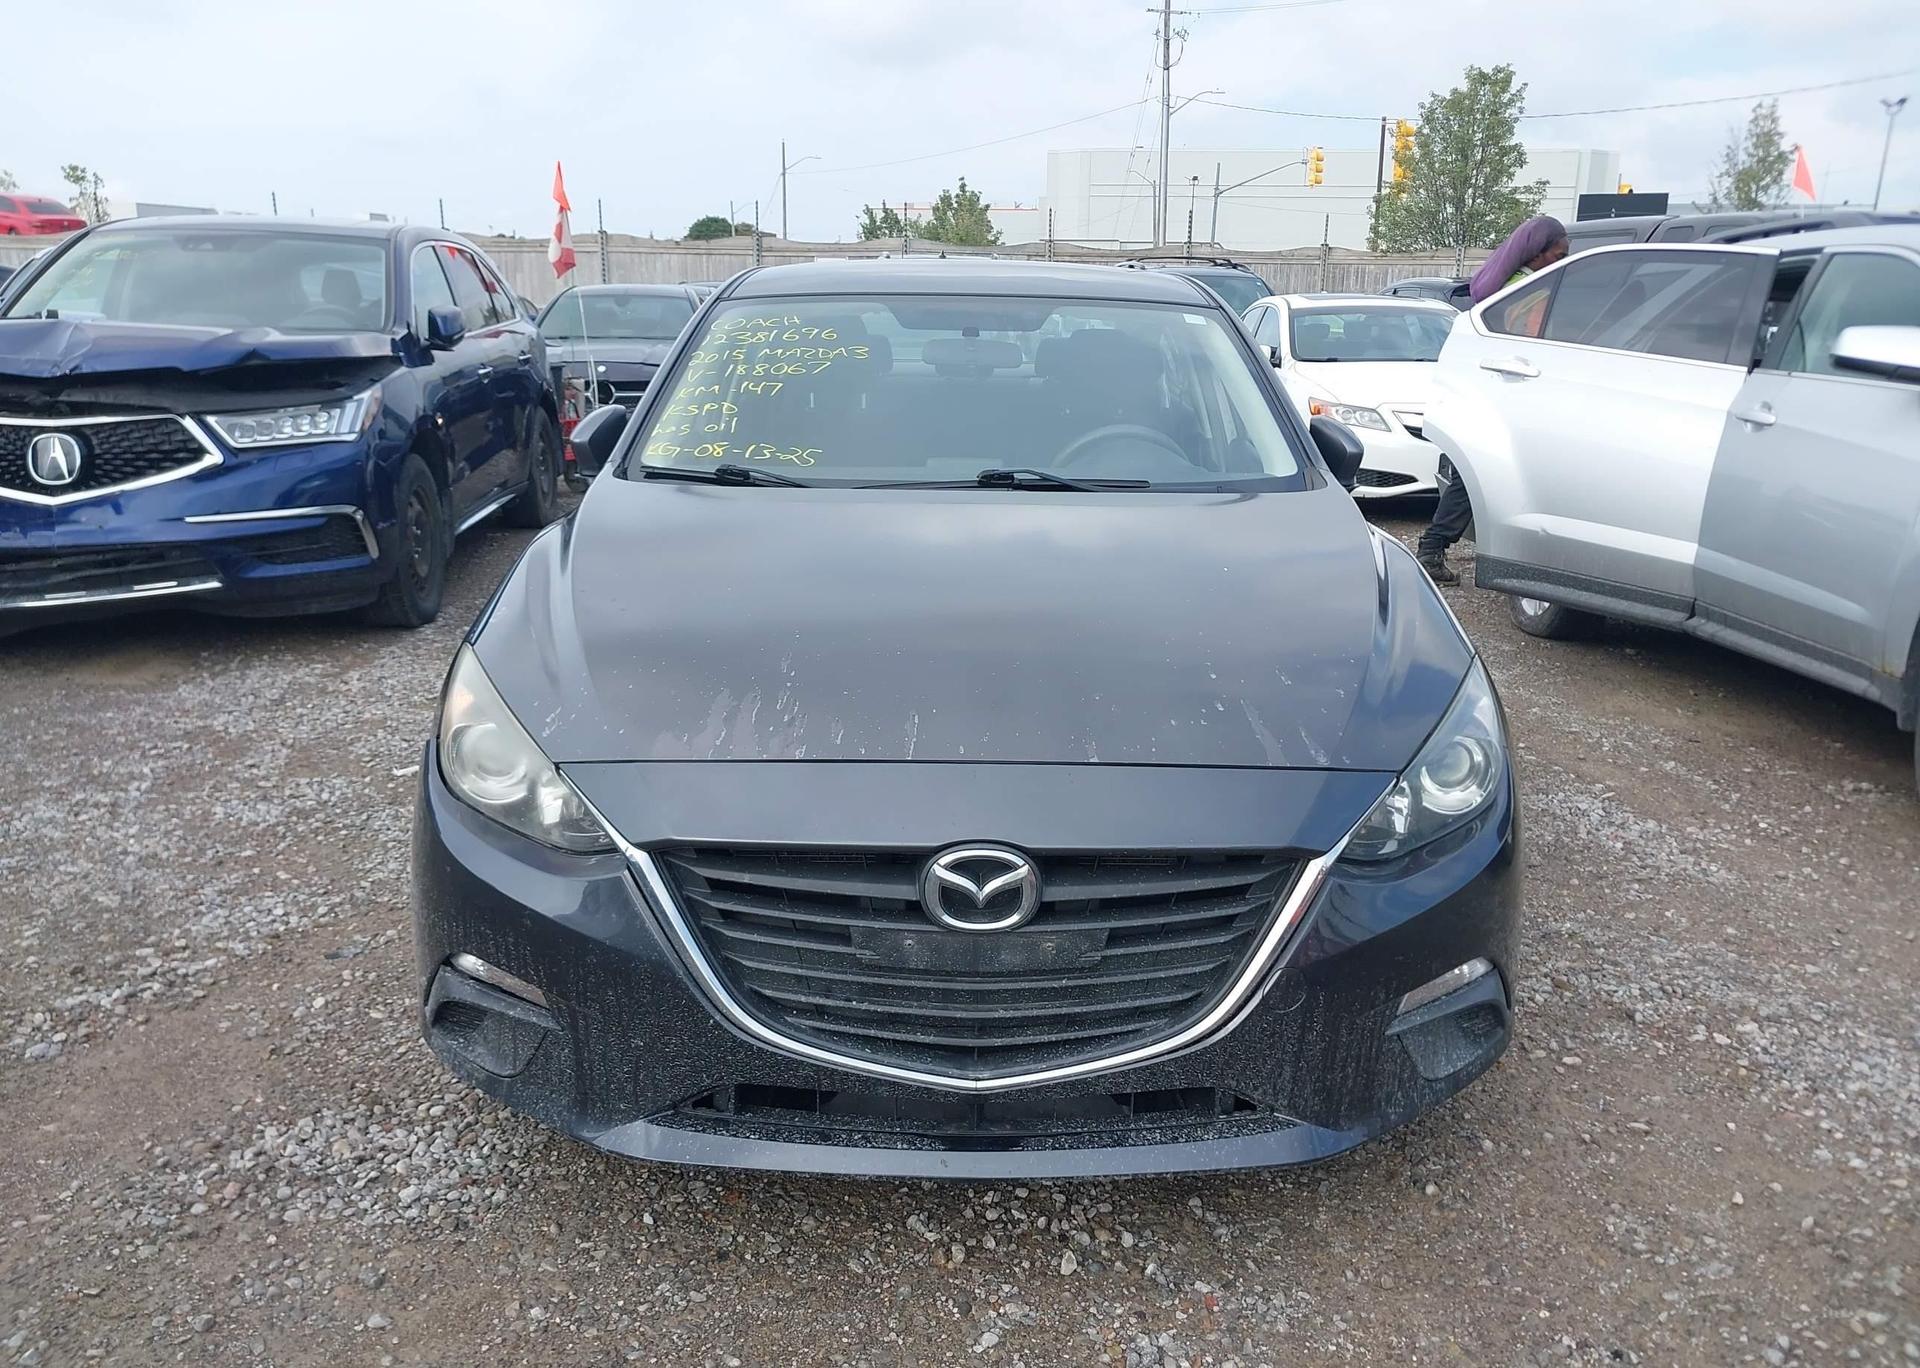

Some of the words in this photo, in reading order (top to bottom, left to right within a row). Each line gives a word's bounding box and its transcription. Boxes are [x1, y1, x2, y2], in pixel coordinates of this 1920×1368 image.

[711, 315, 801, 331] COACH
[702, 327, 838, 345] 12381696
[688, 349, 745, 367] 2015
[759, 346, 870, 359] MAZDA3
[704, 417, 739, 433] oil
